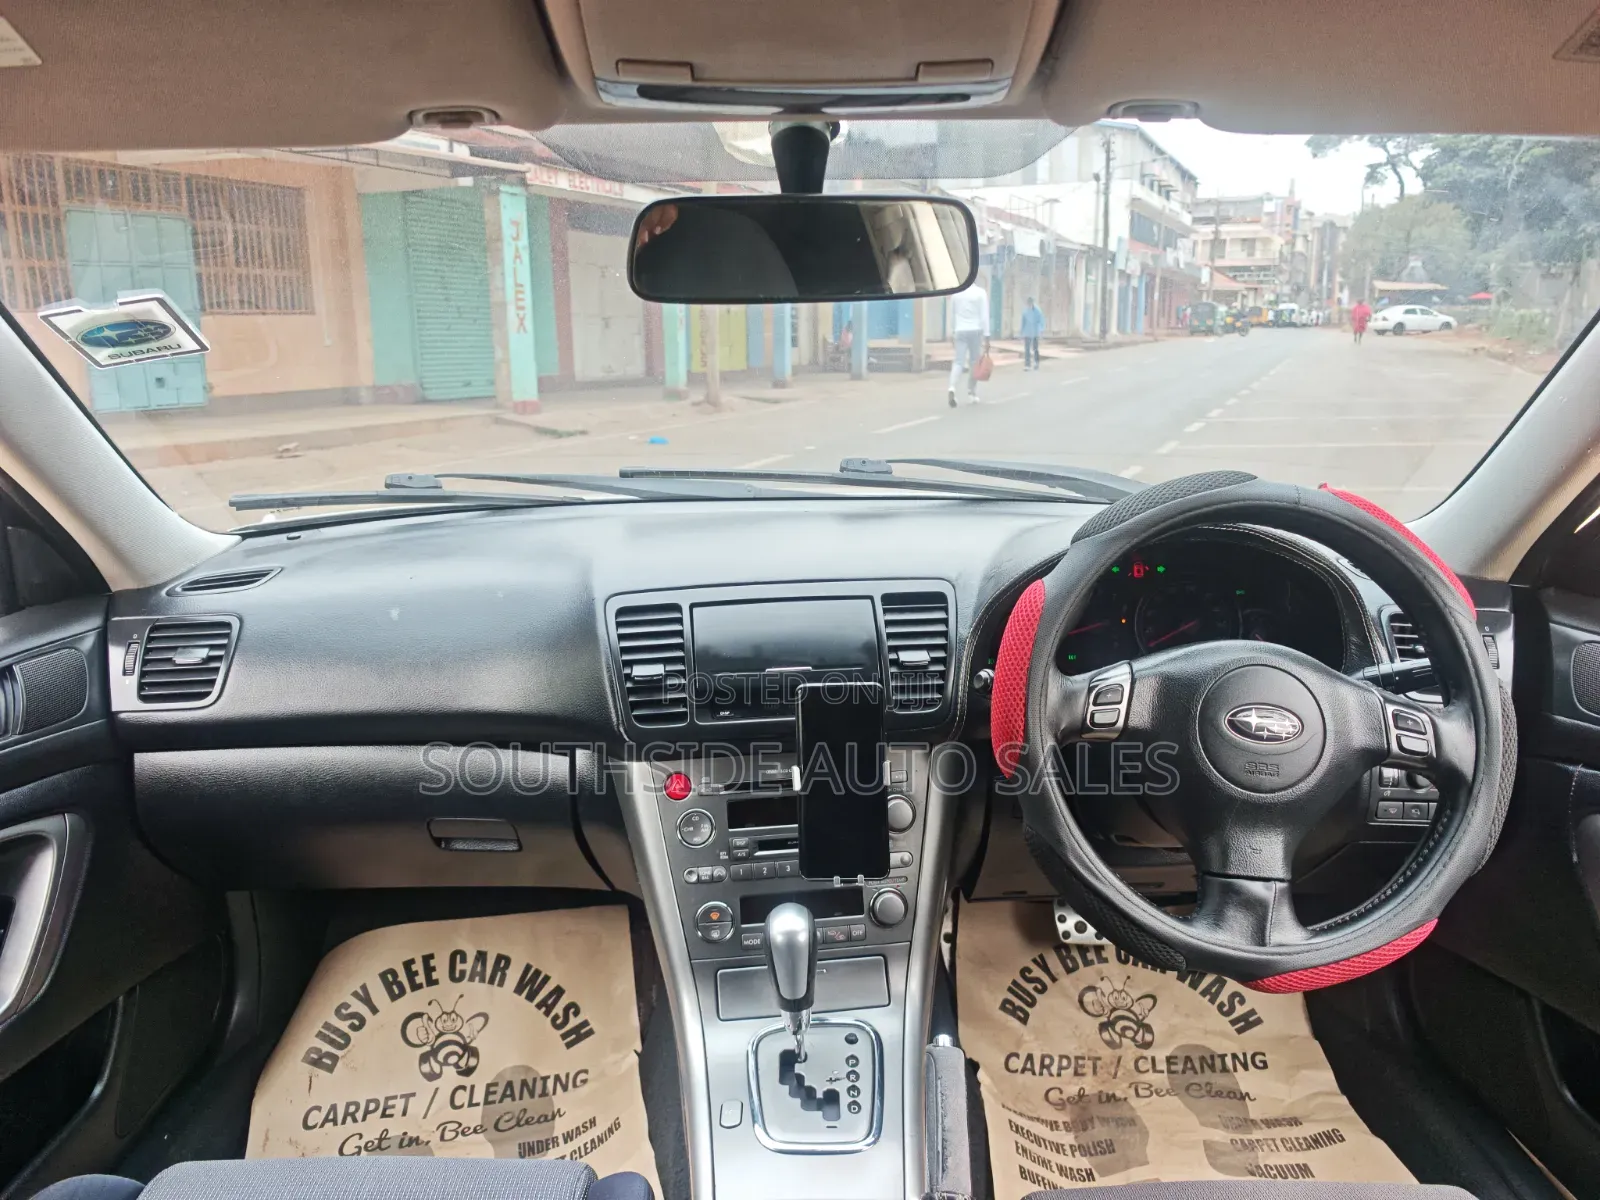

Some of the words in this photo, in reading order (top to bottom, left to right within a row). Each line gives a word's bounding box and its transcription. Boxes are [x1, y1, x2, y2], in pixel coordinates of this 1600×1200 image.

[510, 219, 528, 334] JALEX
[107, 343, 182, 360] SUBARU
[743, 938, 761, 946] MODE
[998, 952, 1059, 1026] BUSY
[1052, 943, 1109, 976] BEE
[300, 982, 380, 1075] BUSY
[378, 952, 440, 1003] BEE
[448, 948, 512, 988] CAR
[513, 962, 596, 1051] WASH
[1003, 1051, 1102, 1078] CARPET
[1133, 1051, 1269, 1076] CLEANING
[301, 1091, 417, 1132] CARPET
[448, 1068, 590, 1111] CLEANING
[1043, 1086, 1092, 1112] Get
[1128, 1081, 1179, 1099] Bee
[1184, 1082, 1257, 1102] Clean
[338, 1128, 392, 1157] Get
[436, 1120, 488, 1143] Bee
[493, 1107, 567, 1133] Clean
[517, 1137, 561, 1159] UNDER
[561, 1116, 597, 1145] WASH
[569, 1116, 622, 1161] CLEANING
[1008, 1118, 1069, 1157] EXECUTIVE
[1069, 1138, 1116, 1159] POLISH
[1280, 1128, 1346, 1152] CLEANING
[1018, 1164, 1066, 1190] BUFFIN
[1055, 1161, 1096, 1183] WASH
[1245, 1162, 1316, 1180] VACUUM
